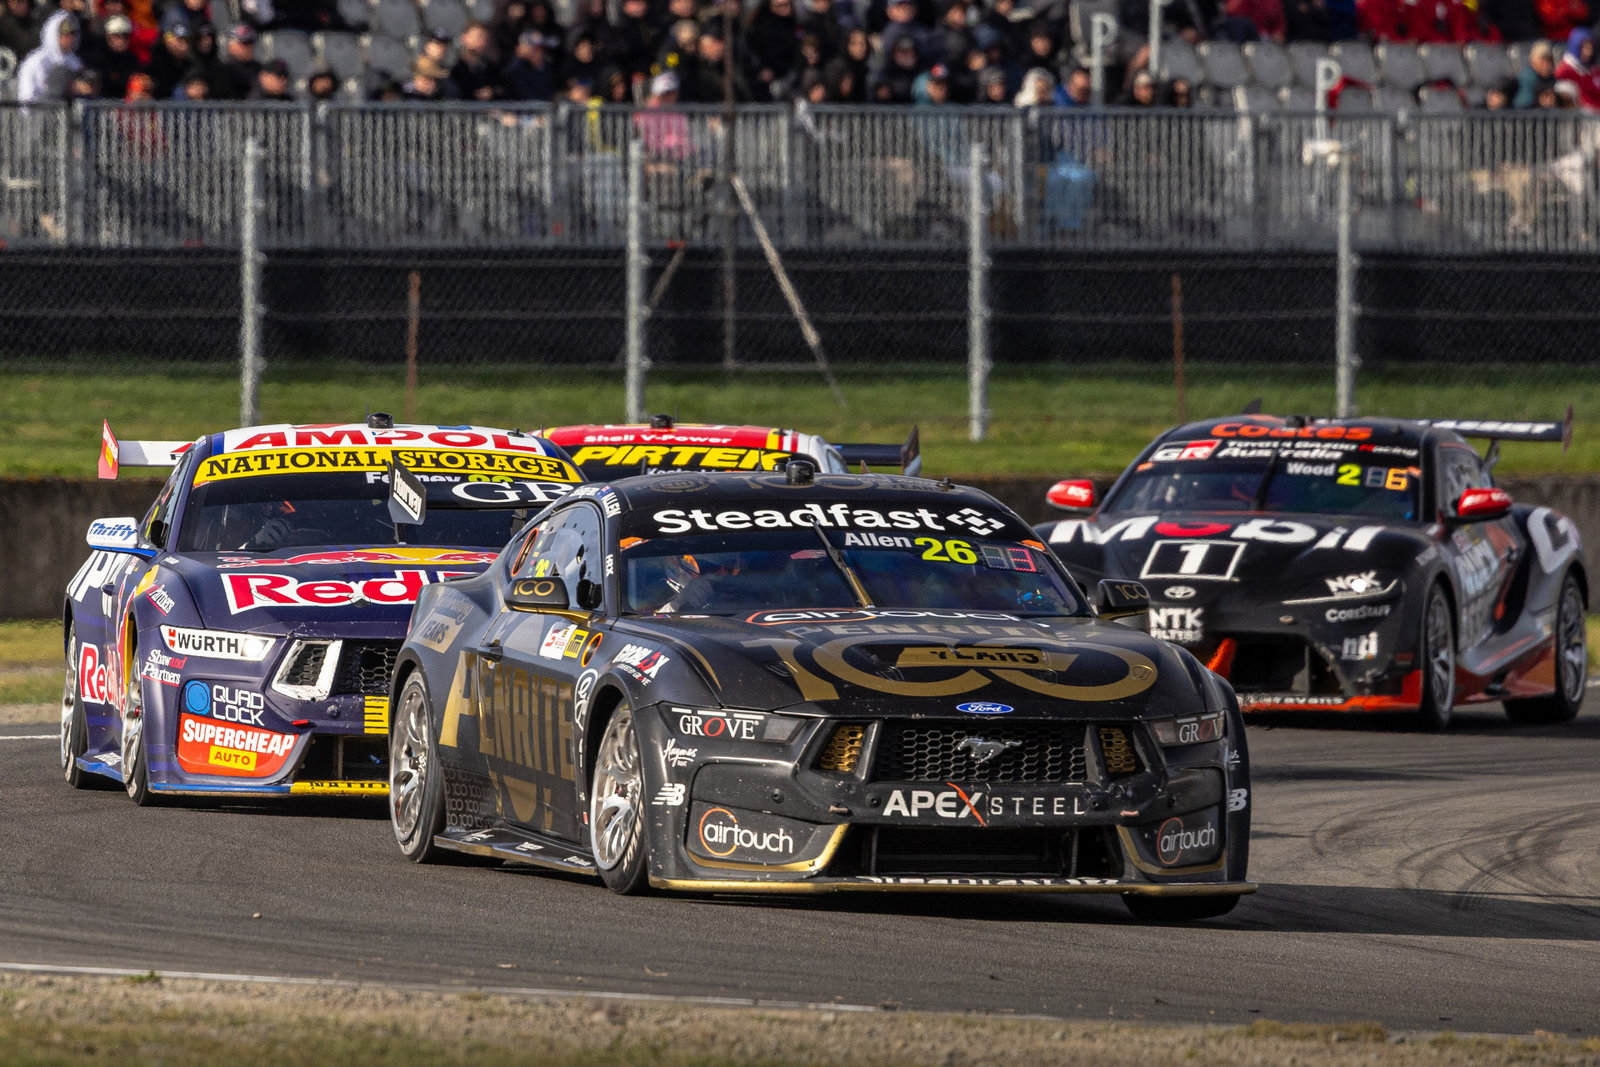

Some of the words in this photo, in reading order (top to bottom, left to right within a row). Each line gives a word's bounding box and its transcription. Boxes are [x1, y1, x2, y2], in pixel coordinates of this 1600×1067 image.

[234, 430, 537, 453] AMPOL
[583, 434, 634, 443] Shell
[640, 434, 732, 444] V-Power
[1210, 423, 1374, 441] Coates
[206, 449, 389, 478] NATIONAL
[399, 451, 563, 478] STORAGE
[573, 446, 792, 472] PIRTEK
[1286, 462, 1337, 477] Wood
[1336, 464, 1363, 486] 2
[89, 522, 138, 541] Thrifty
[653, 503, 946, 534] Steadfast
[1049, 515, 1386, 552] Mobil
[845, 532, 912, 548] Allen
[914, 537, 978, 564] 26
[1178, 544, 1210, 575] 1
[221, 570, 426, 615] Red
[1149, 607, 1204, 629] NTK
[177, 633, 239, 654] WÜRTH
[424, 620, 449, 645] YEARS
[142, 661, 181, 685] Partners
[739, 635, 1158, 701] 100
[212, 683, 265, 710] QUAD
[212, 704, 265, 727] LOCK
[679, 714, 756, 740] GROVE
[182, 718, 295, 757] SUPERCHEAP
[213, 753, 252, 766] AUTO
[883, 782, 988, 827] APEX
[990, 796, 1086, 816] STEEL
[703, 821, 794, 854] airtouch
[1160, 822, 1216, 853] airtouch
